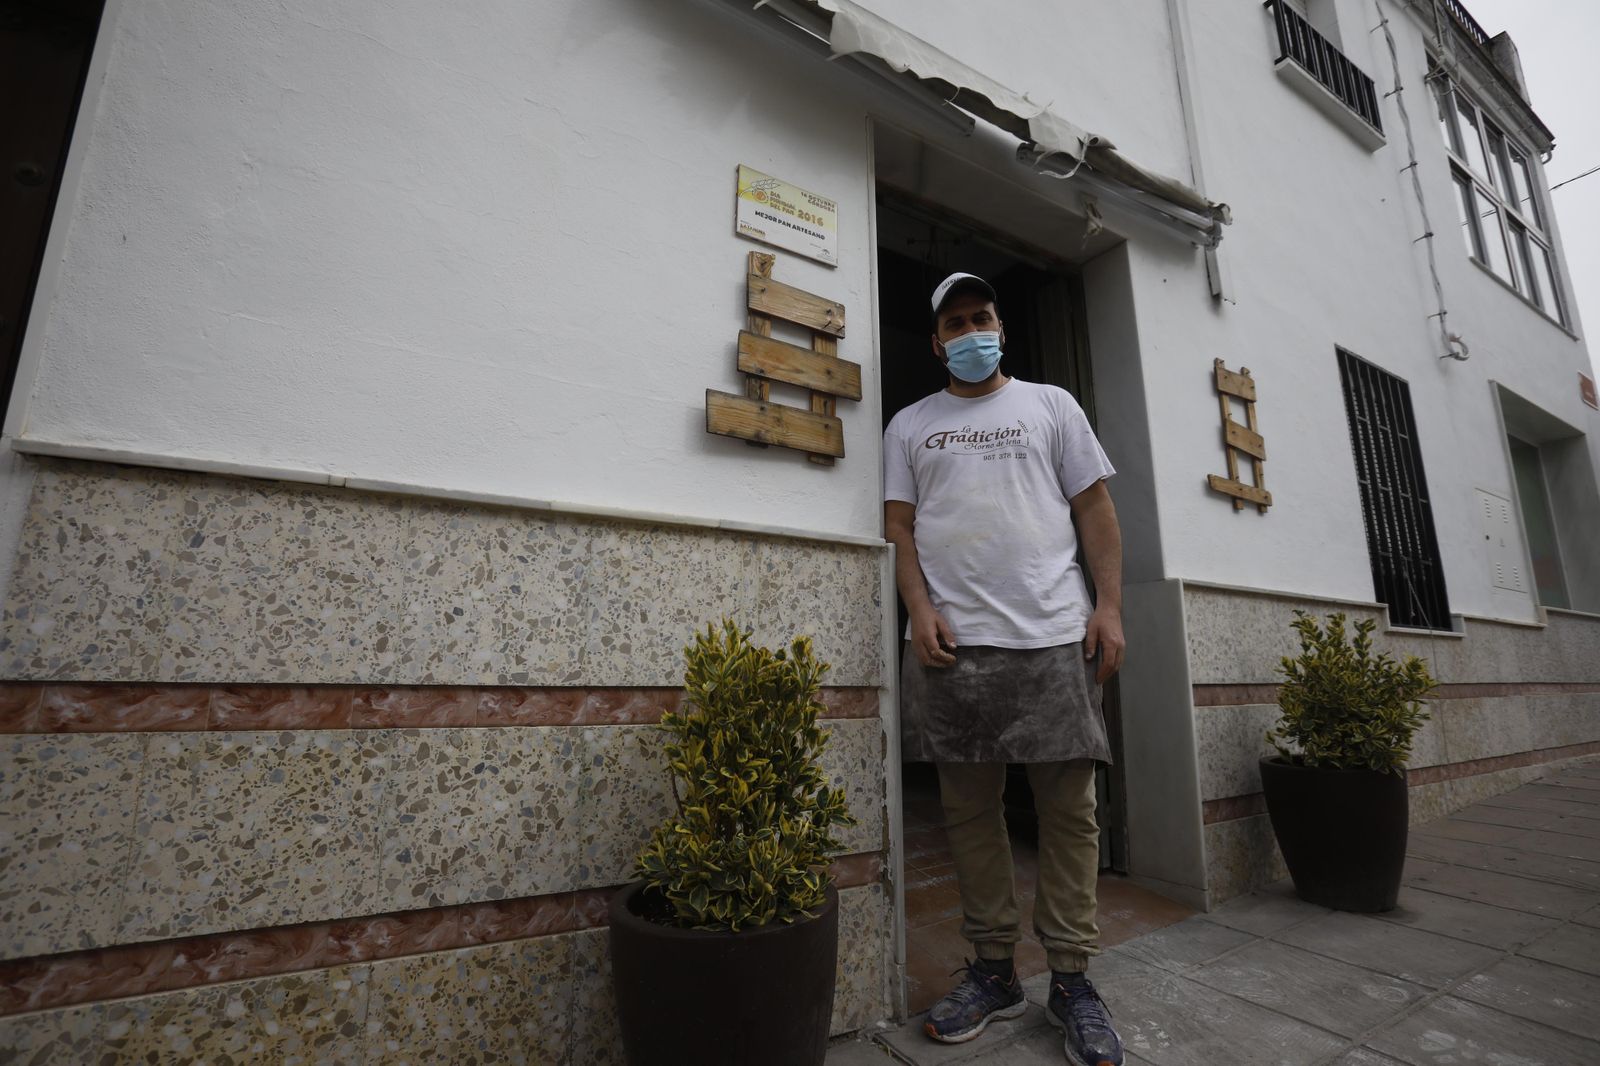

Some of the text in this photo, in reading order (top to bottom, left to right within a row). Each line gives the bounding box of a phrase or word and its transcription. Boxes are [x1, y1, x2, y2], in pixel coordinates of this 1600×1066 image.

[770, 203, 781, 212] DEL
[797, 209, 824, 227] 2016
[755, 211, 777, 223] MEJOR
[778, 218, 791, 228] PAN
[792, 222, 825, 240] ARTESANO
[961, 425, 972, 434] La
[925, 427, 1022, 450] Tradición
[964, 442, 995, 450] Horno
[996, 440, 1004, 448] de
